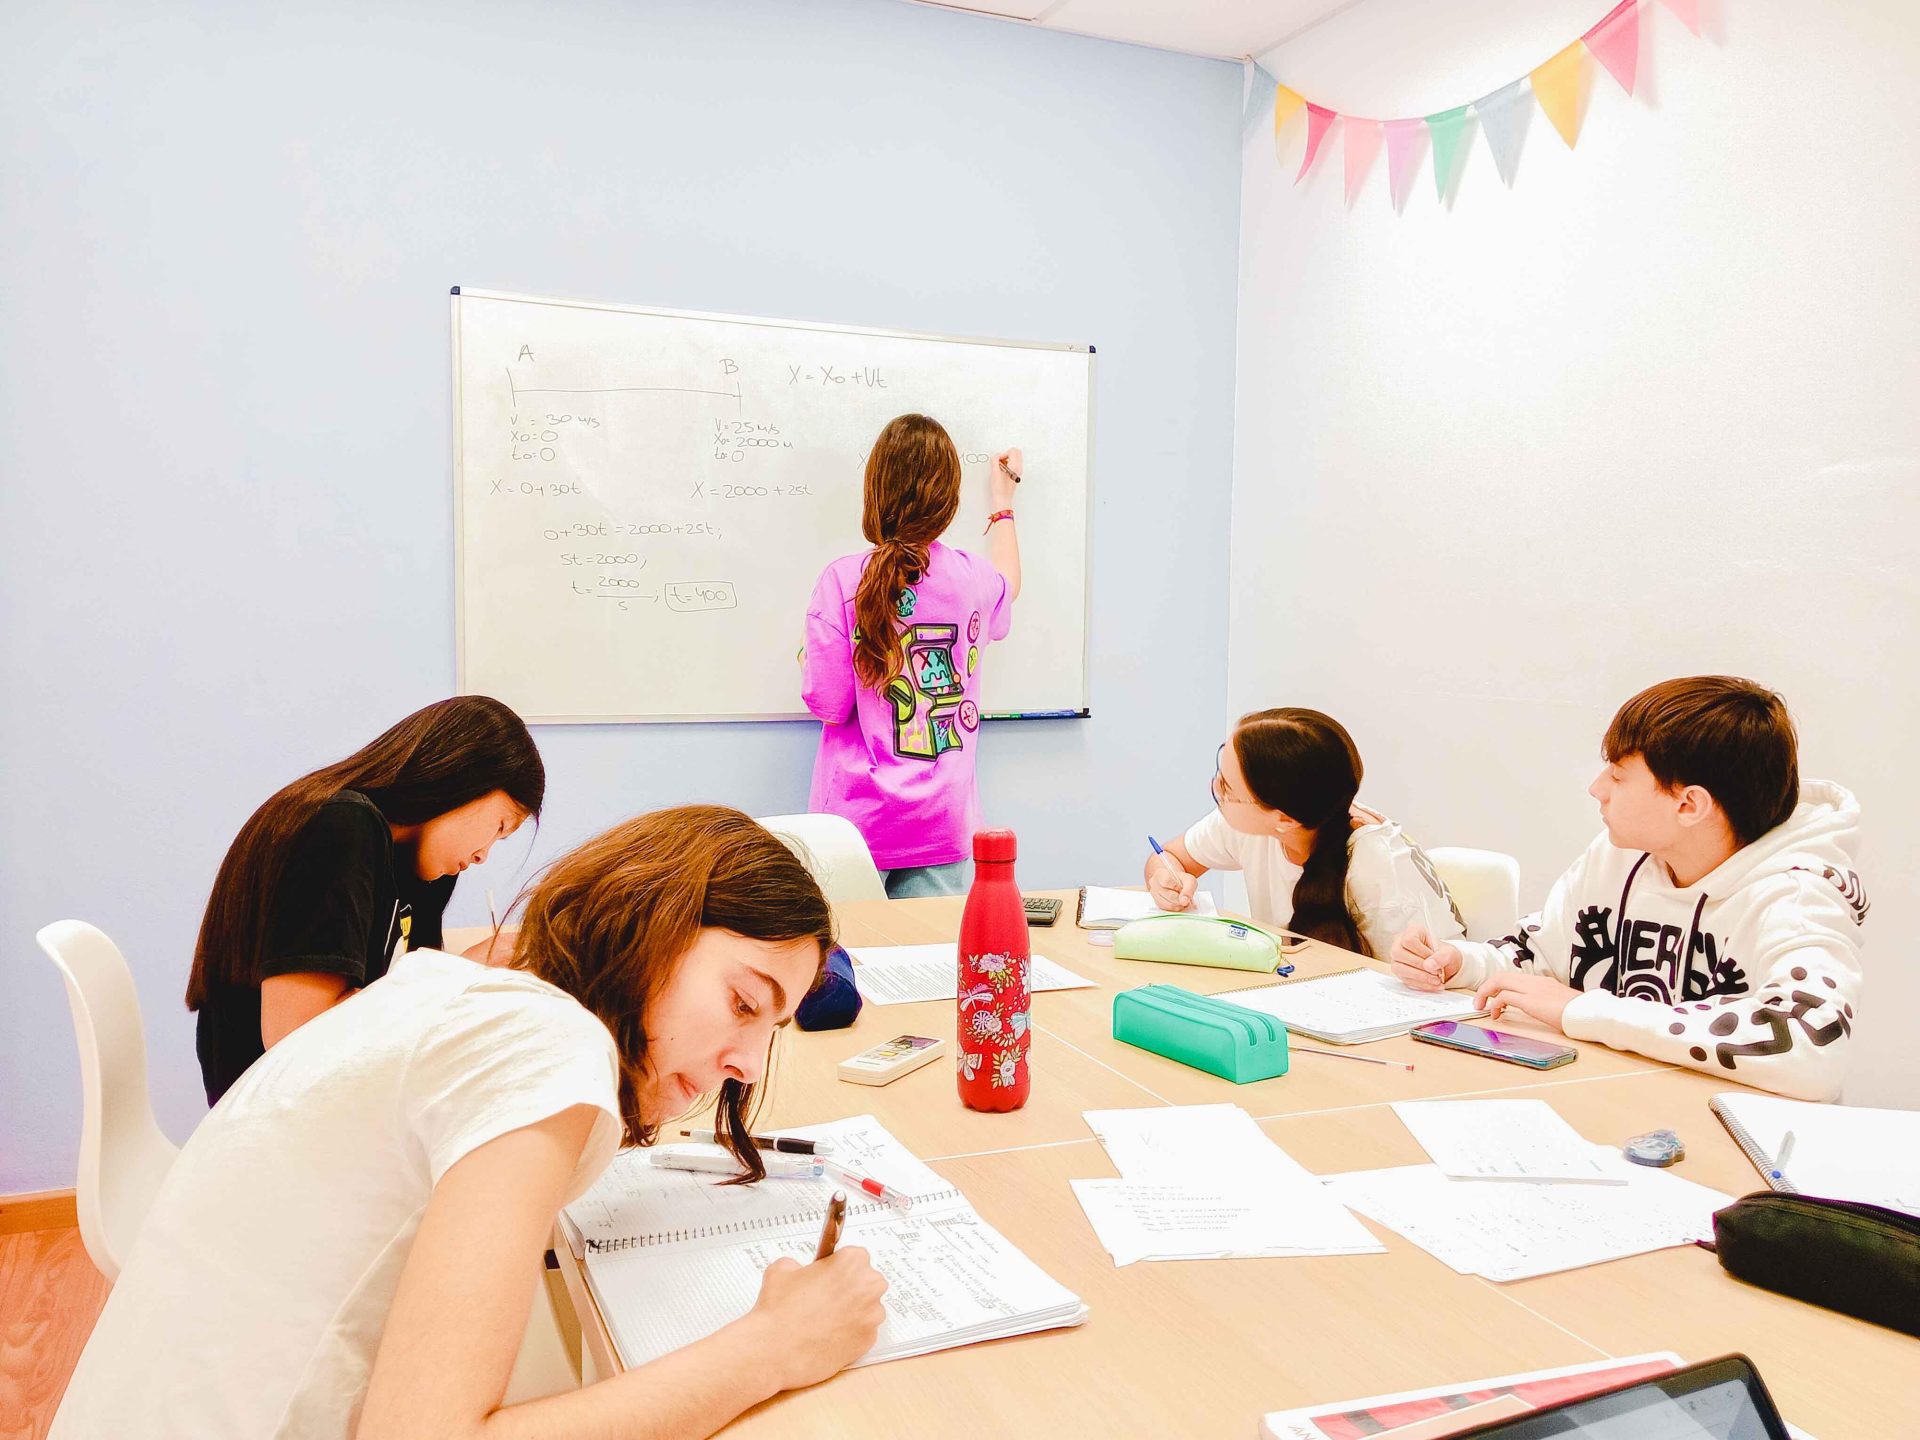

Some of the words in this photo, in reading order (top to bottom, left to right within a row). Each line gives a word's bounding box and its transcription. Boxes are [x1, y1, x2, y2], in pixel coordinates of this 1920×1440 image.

[518, 344, 535, 362] A
[719, 358, 740, 375] B
[545, 413, 573, 426] 30
[598, 575, 640, 588] 2000
